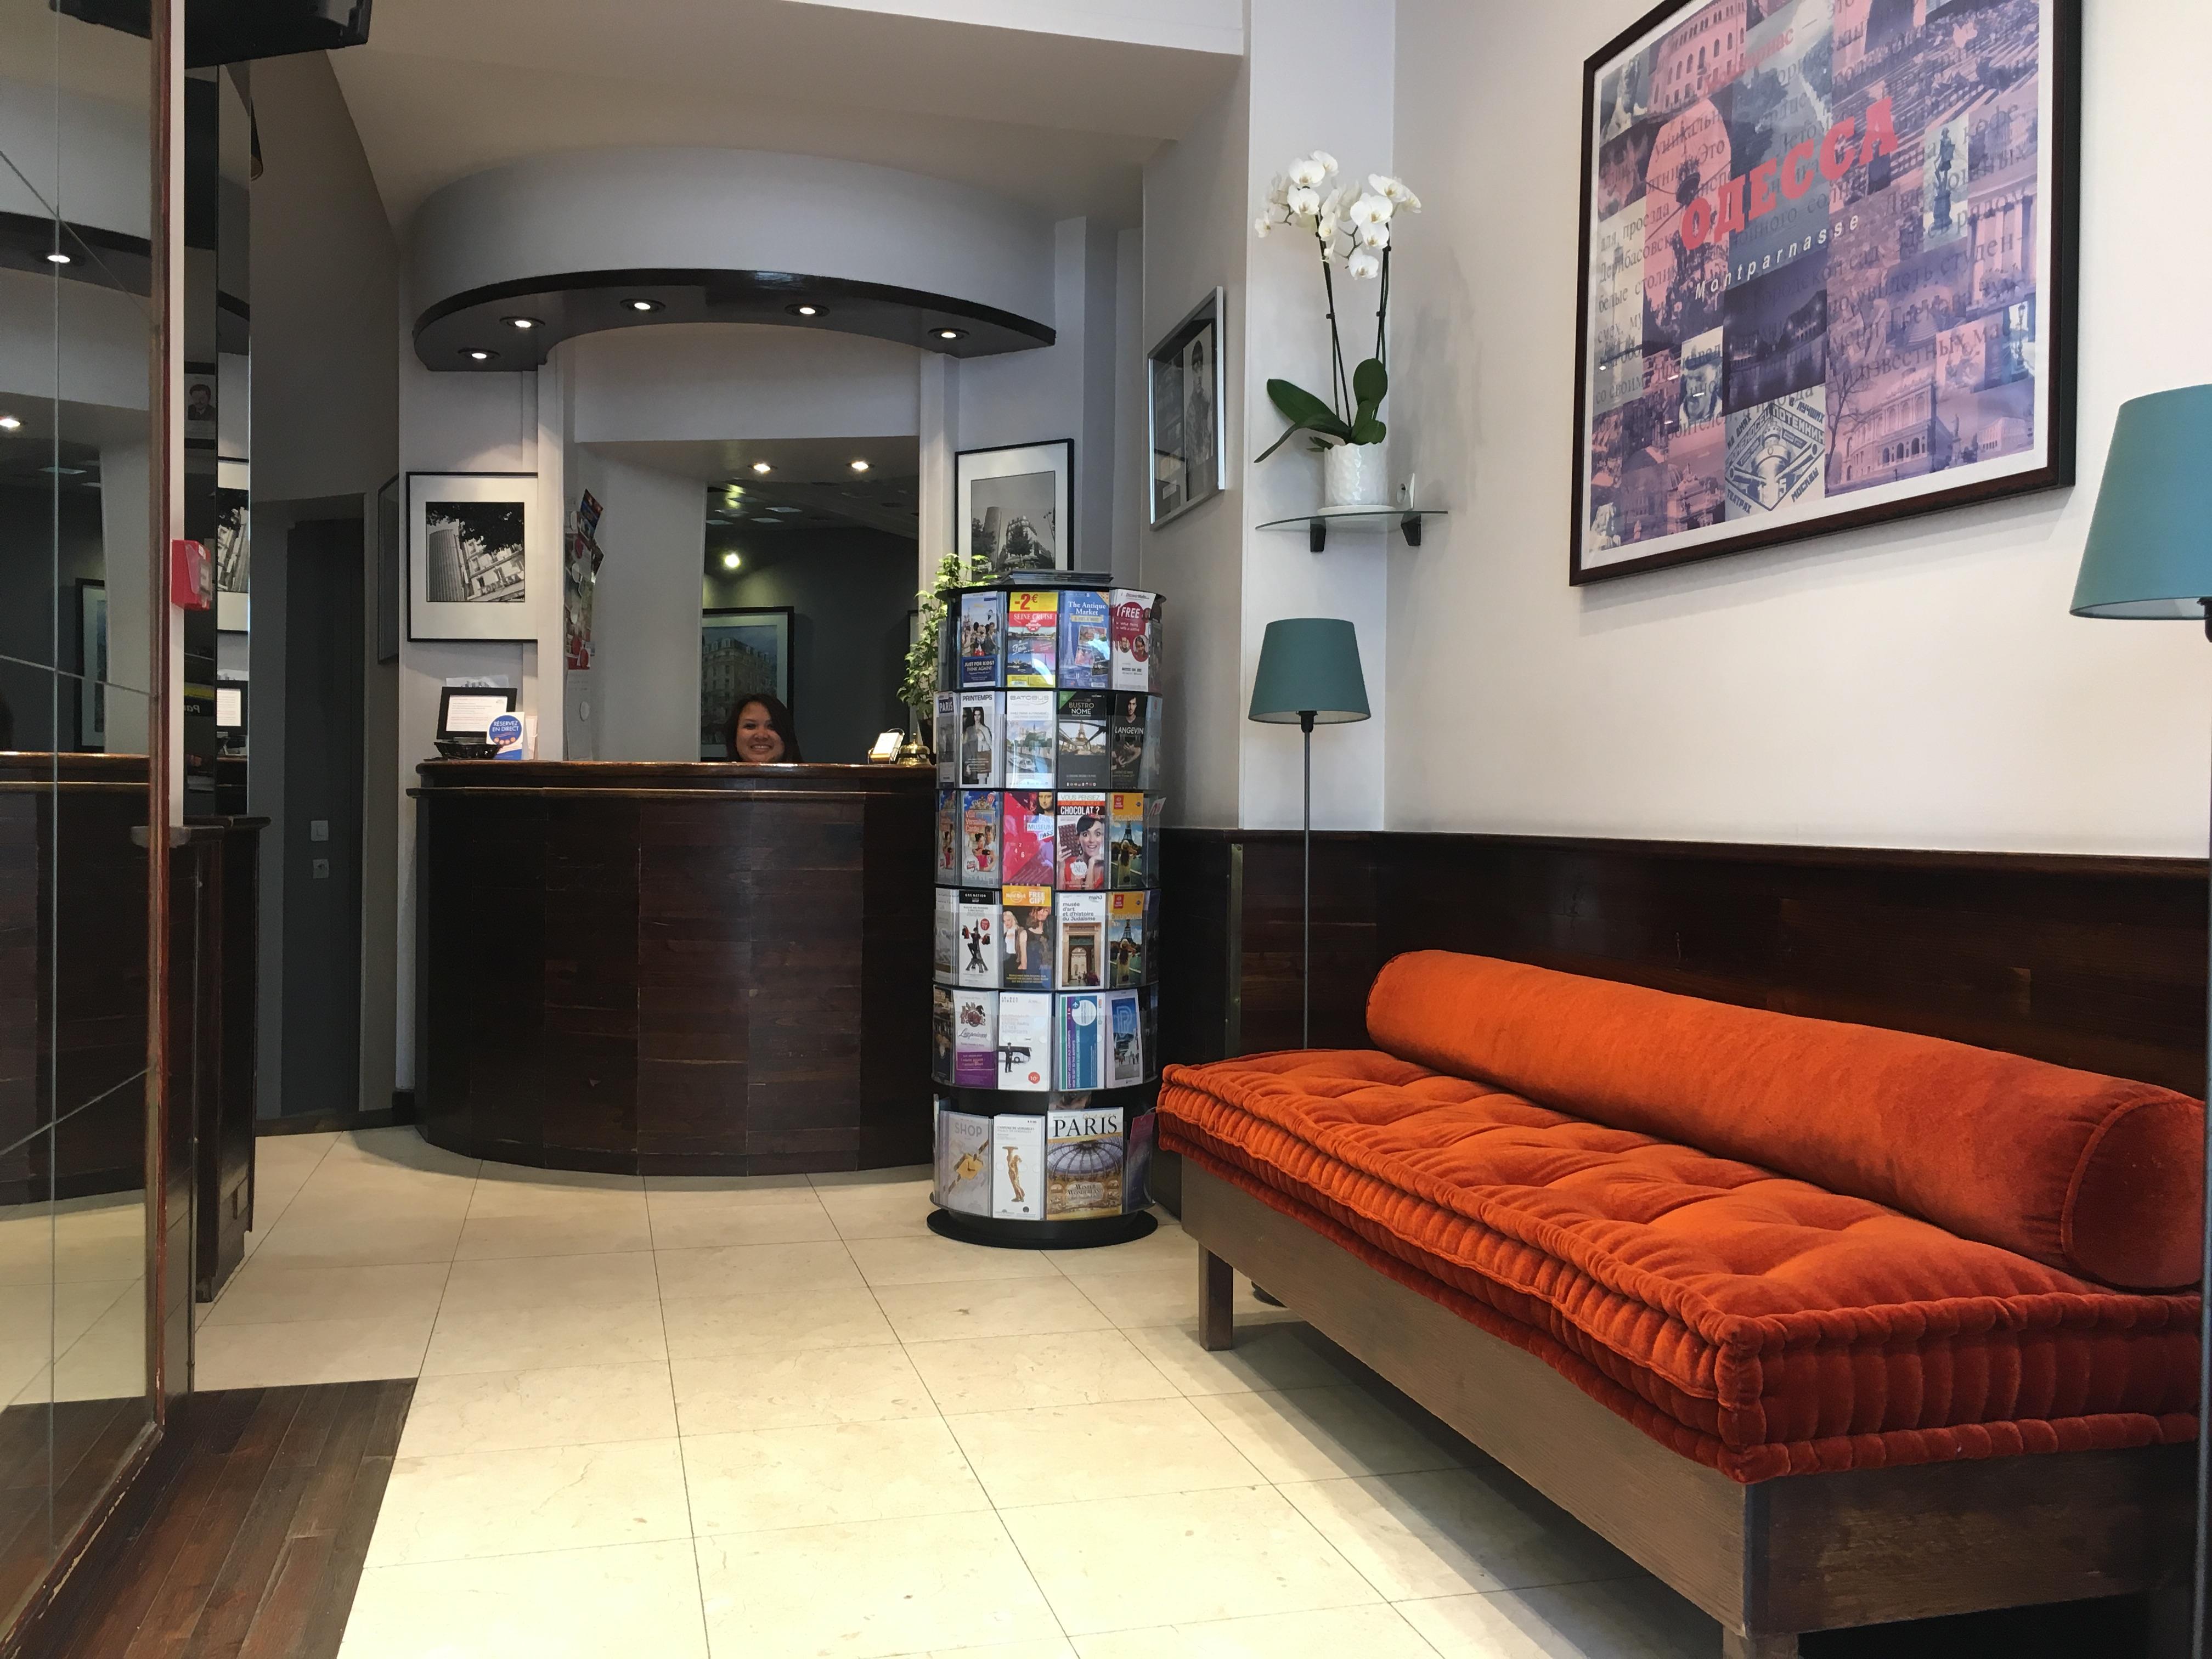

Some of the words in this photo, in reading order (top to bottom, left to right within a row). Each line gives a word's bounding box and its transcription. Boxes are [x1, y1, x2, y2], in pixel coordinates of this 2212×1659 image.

[1681, 97, 1898, 251] ОДЕССА
[1695, 215, 1859, 302] Montparnasse
[1082, 602, 1106, 611] Antique
[1121, 607, 1141, 619] FREE
[939, 701, 953, 712] PARIS
[1115, 726, 1144, 735] LANGEVIN
[1060, 806, 1093, 815] CHOCOLAT
[955, 1122, 982, 1137] SHOP
[1053, 1115, 1118, 1138] PARIS
